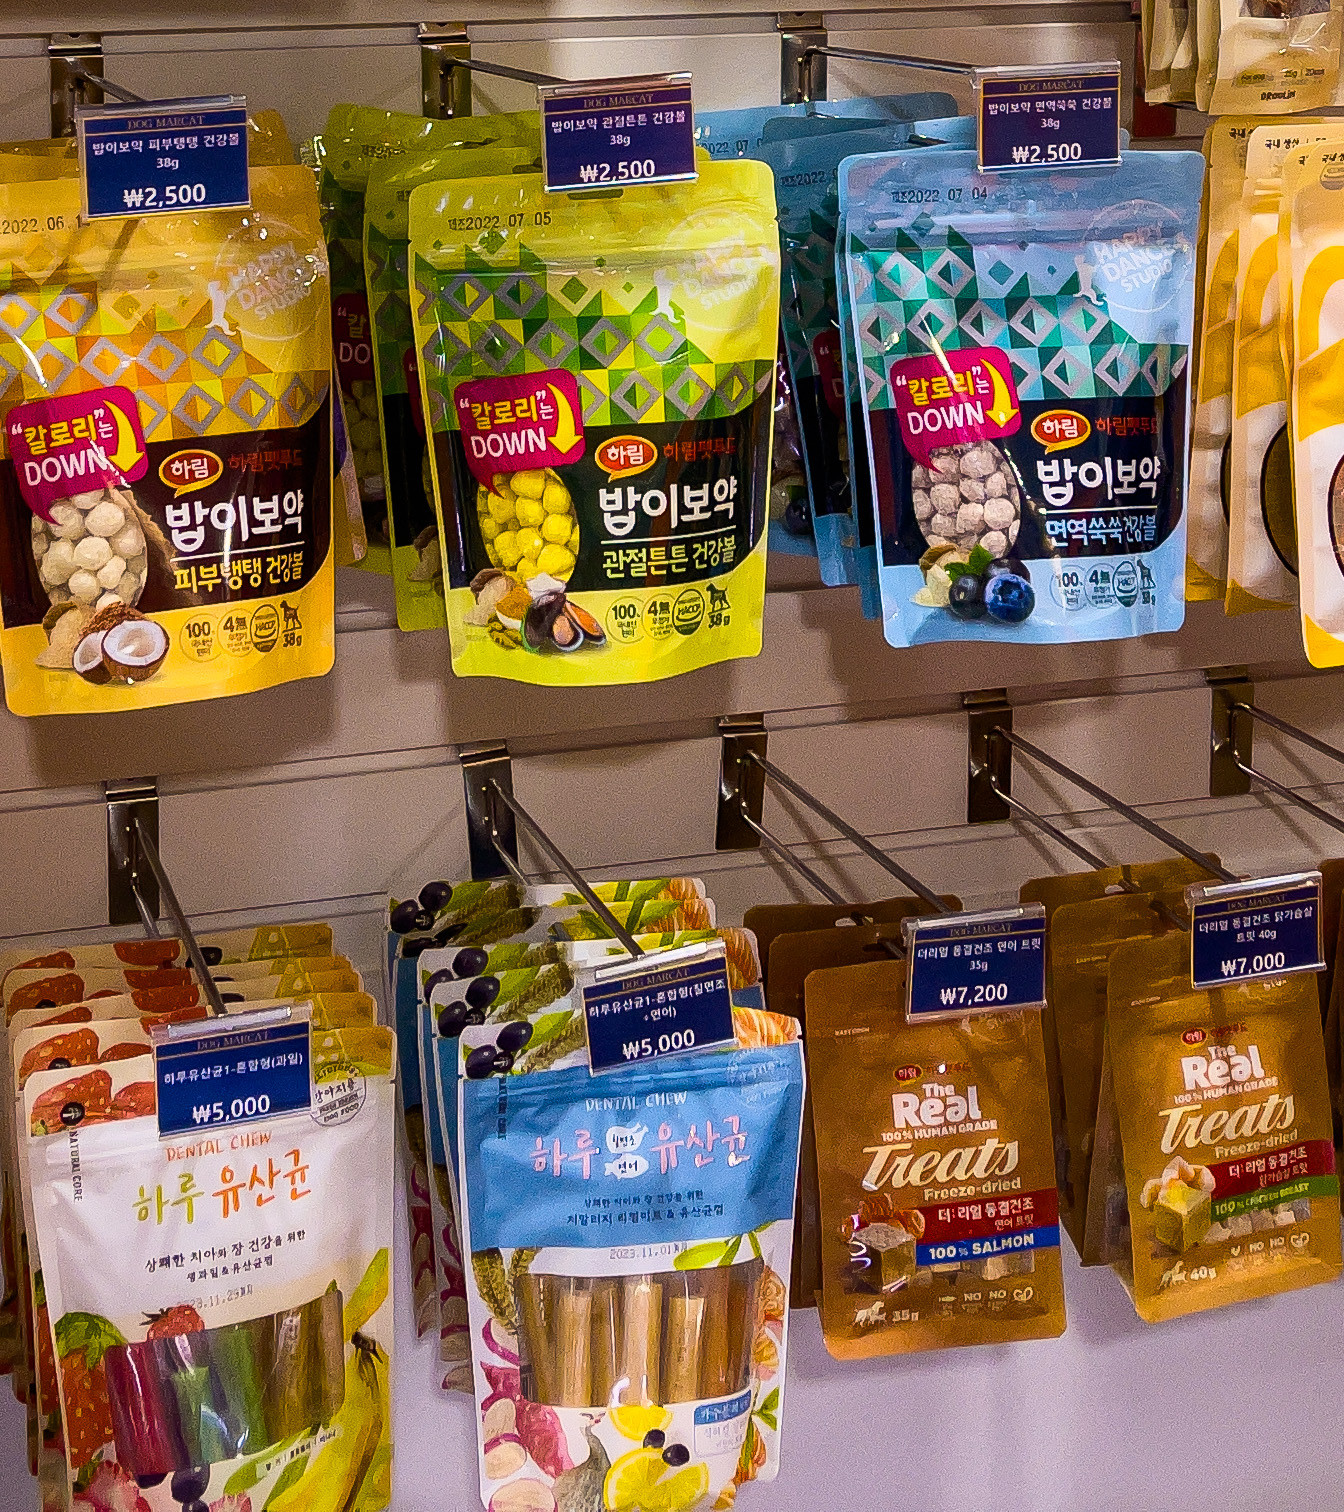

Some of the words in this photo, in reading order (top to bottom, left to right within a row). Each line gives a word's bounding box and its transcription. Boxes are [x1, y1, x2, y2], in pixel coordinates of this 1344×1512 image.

[610, 134, 630, 147] 38g
[1040, 117, 1060, 129] 38g
[157, 157, 179, 170] 38g
[907, 402, 984, 433] DOWN
[471, 428, 546, 458] DOWN
[24, 449, 106, 485] DOWN
[1037, 457, 1160, 506] 밥이보약
[167, 496, 304, 553] 밥이보약
[598, 479, 738, 535] 밥이보약
[1182, 1049, 1265, 1089] Real
[892, 1089, 982, 1129] Real
[922, 1083, 955, 1098] The
[1158, 1091, 1295, 1154] Treats
[530, 1134, 599, 1177] 하루
[652, 1116, 750, 1168] 유산균
[863, 1137, 1020, 1191] Treats
[133, 1176, 204, 1227] 하루
[214, 1150, 312, 1214] 유산균
